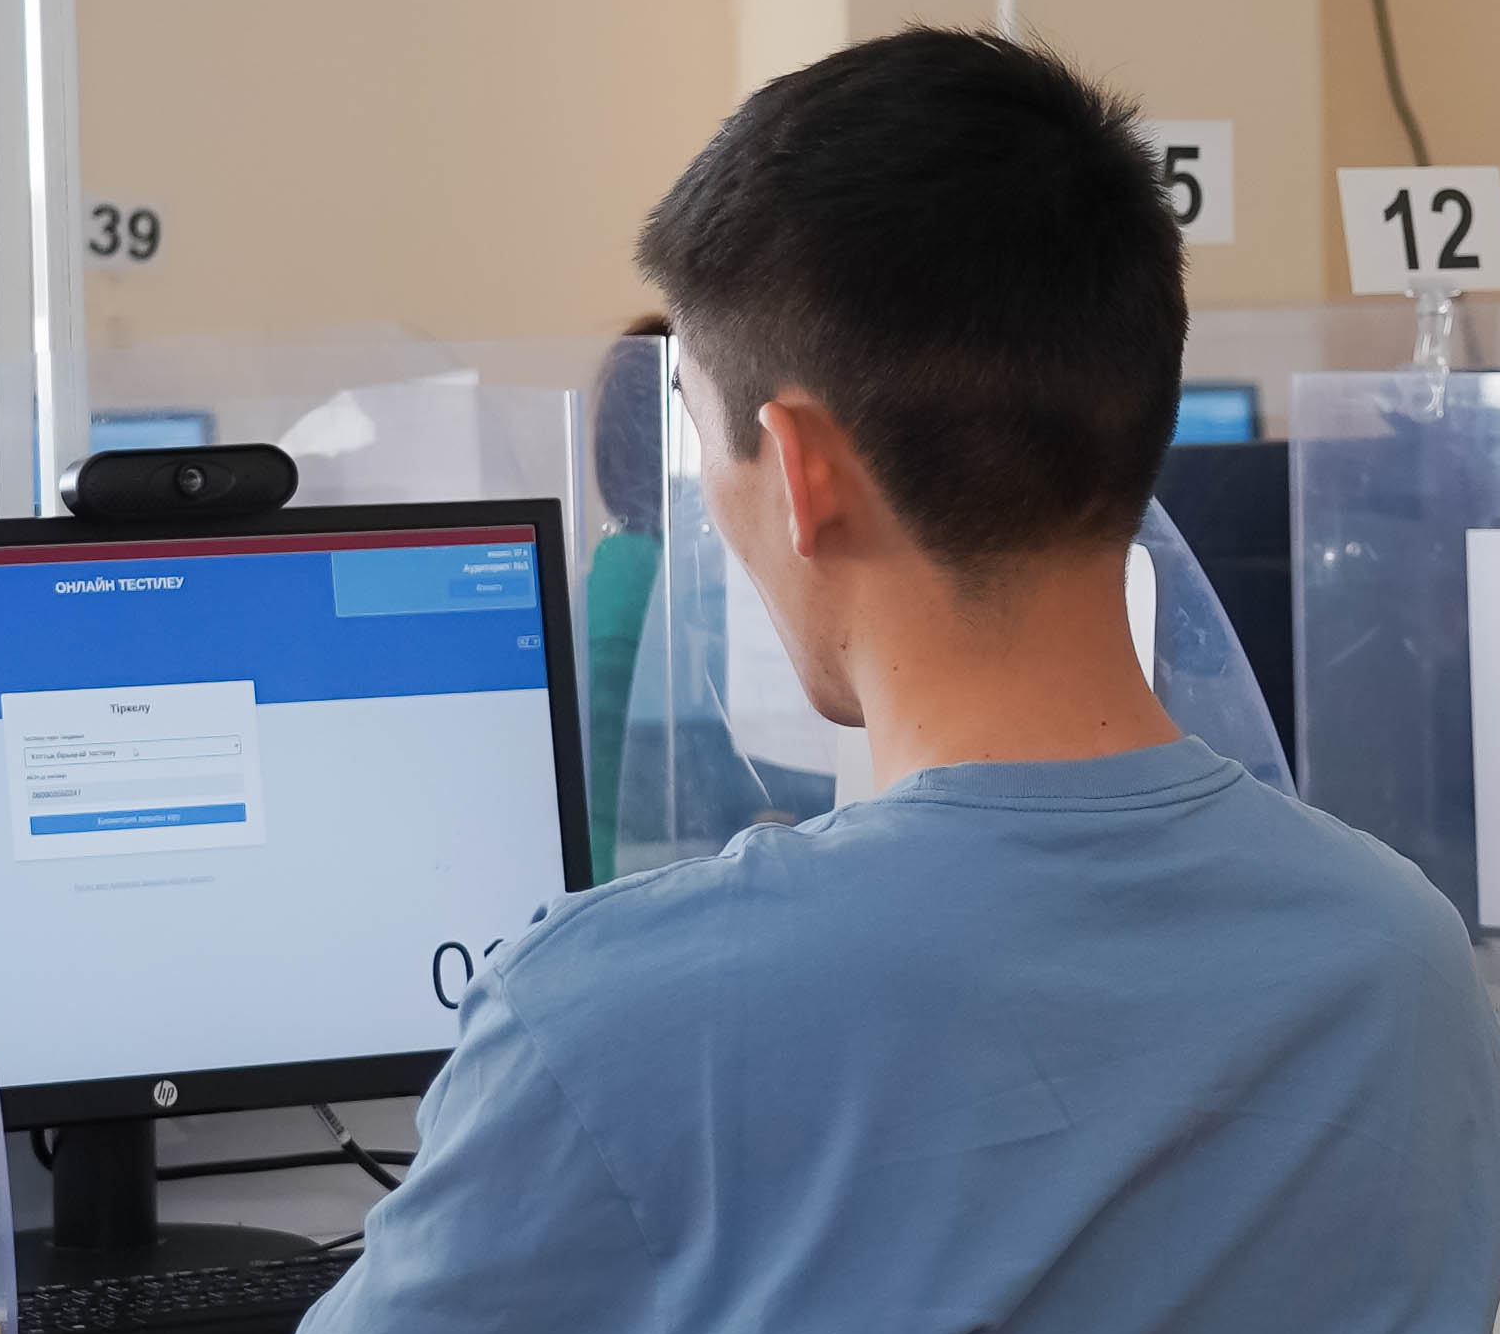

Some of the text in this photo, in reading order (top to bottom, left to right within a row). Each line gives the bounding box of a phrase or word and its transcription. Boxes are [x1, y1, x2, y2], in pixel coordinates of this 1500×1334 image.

[87, 203, 162, 261] 39
[1383, 188, 1481, 270] 12
[55, 576, 184, 594] ОНЛАЙН ТЕСТІЛЕУ
[155, 1079, 177, 1107] hp
